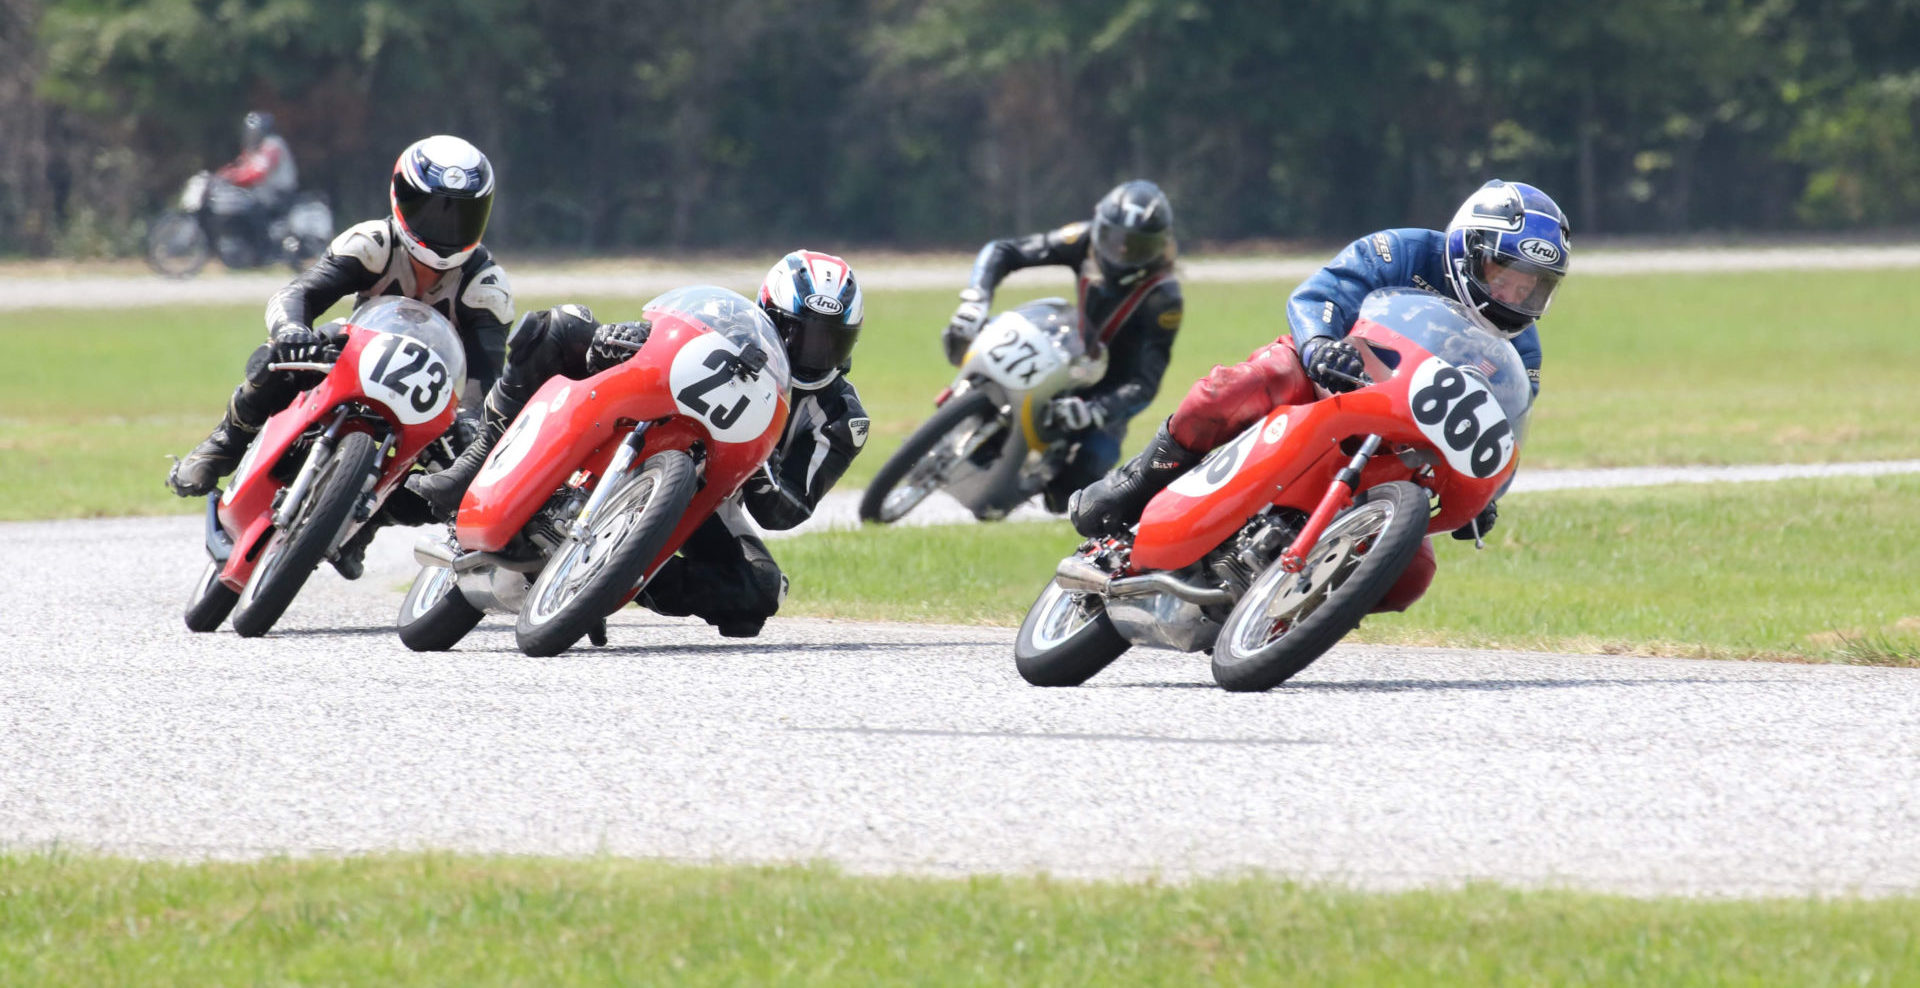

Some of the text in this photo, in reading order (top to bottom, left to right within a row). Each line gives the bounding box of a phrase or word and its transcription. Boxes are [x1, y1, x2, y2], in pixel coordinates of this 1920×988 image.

[1523, 242, 1556, 259] Arai
[809, 296, 838, 310] Arai
[369, 335, 447, 413] 123
[677, 349, 751, 430] 2J
[1412, 367, 1511, 478] 866
